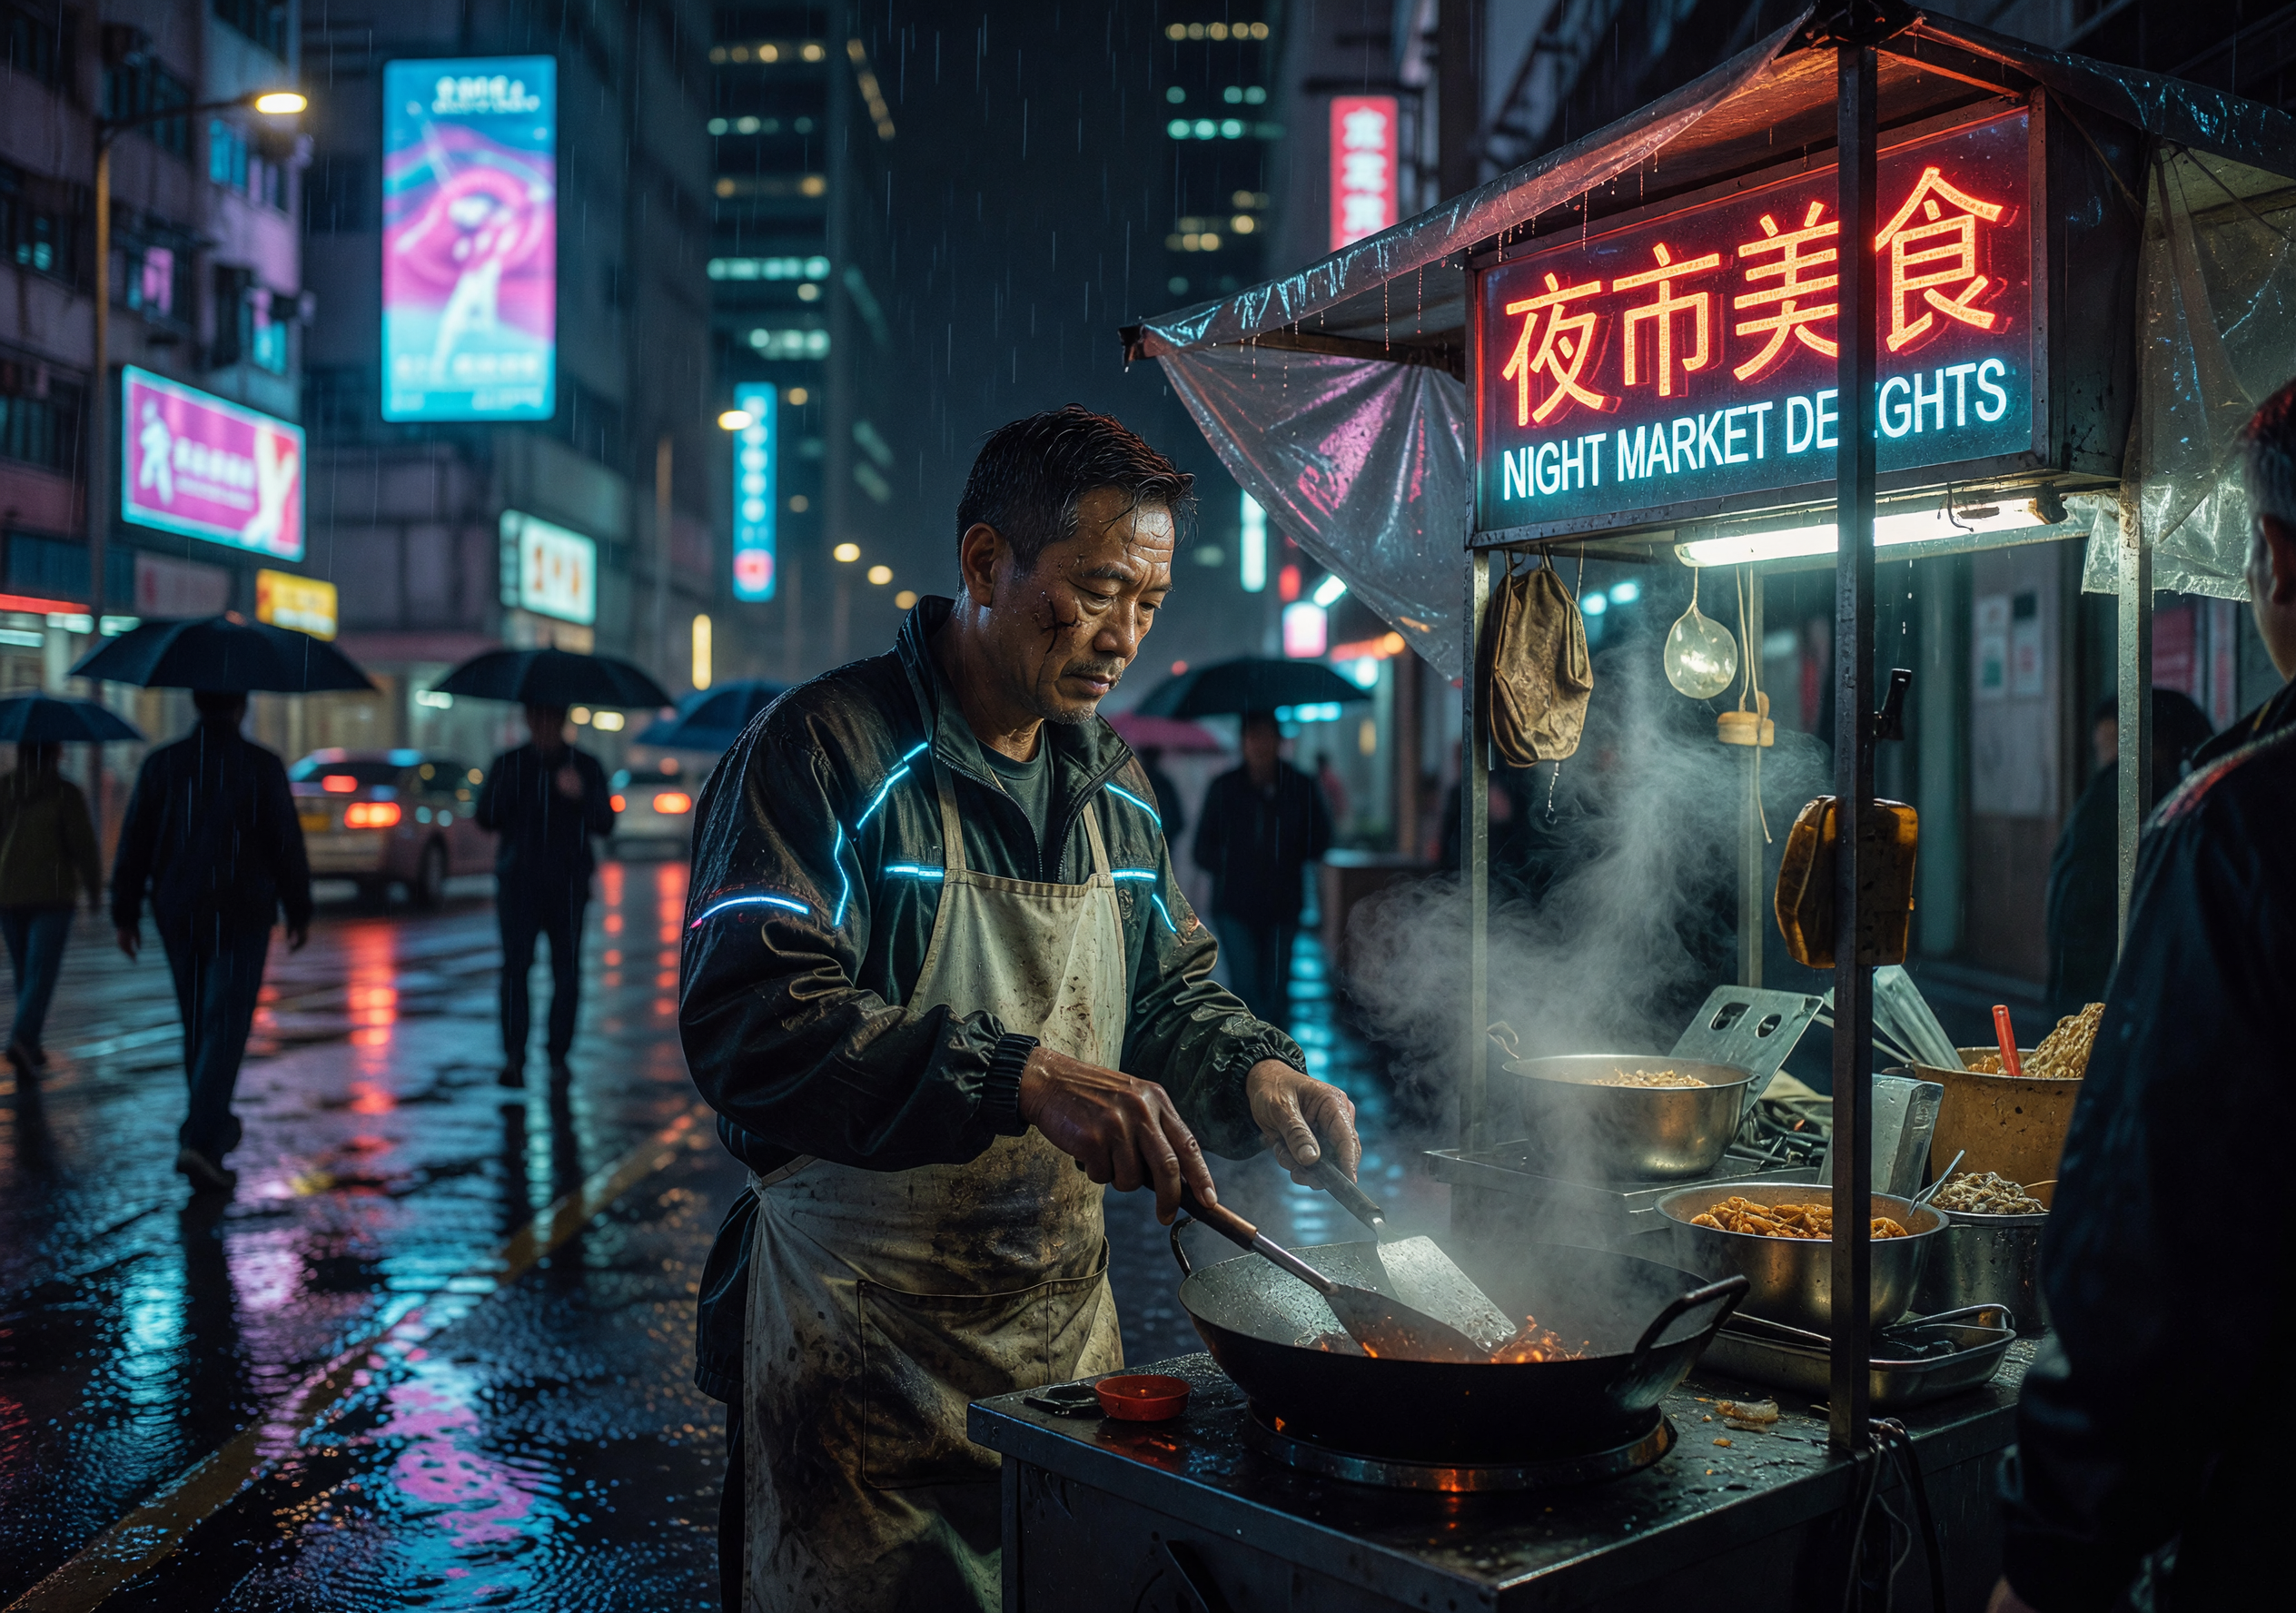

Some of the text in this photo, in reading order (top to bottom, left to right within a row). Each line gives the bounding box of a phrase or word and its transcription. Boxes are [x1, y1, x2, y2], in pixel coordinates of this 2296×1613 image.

[1501, 166, 2004, 426] 夜市美食
[1503, 358, 2008, 501] NIGHT MARKET DEGHTS
